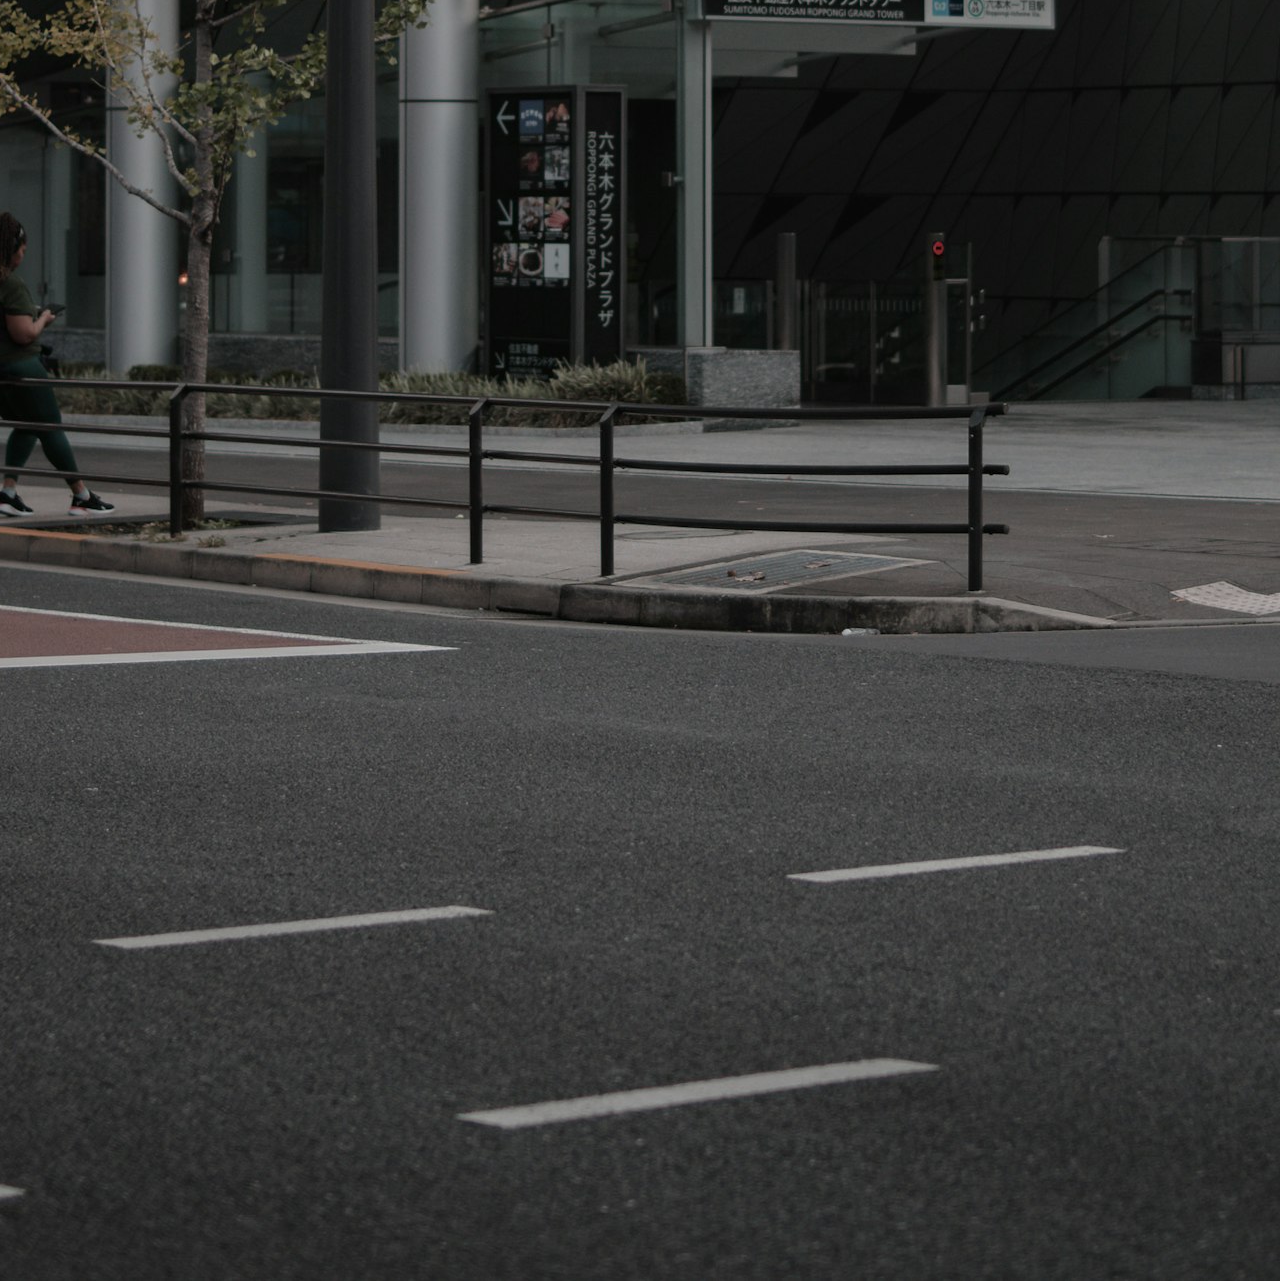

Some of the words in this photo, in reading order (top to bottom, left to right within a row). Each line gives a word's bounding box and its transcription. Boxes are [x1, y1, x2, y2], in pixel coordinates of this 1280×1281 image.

[723, 5, 767, 16] SUMITOMO
[770, 6, 807, 16] FUDOSAN
[807, 7, 846, 17] ROPPONGI
[848, 8, 876, 18] GRAND
[877, 9, 904, 19] TOWER
[985, 0, 1046, 12] 六本木一丁目駅
[586, 130, 598, 196] ROPPONGI
[586, 199, 597, 245] GRAND
[597, 130, 615, 328] 六本木グランドプラザ
[586, 248, 597, 289] PLAZA
